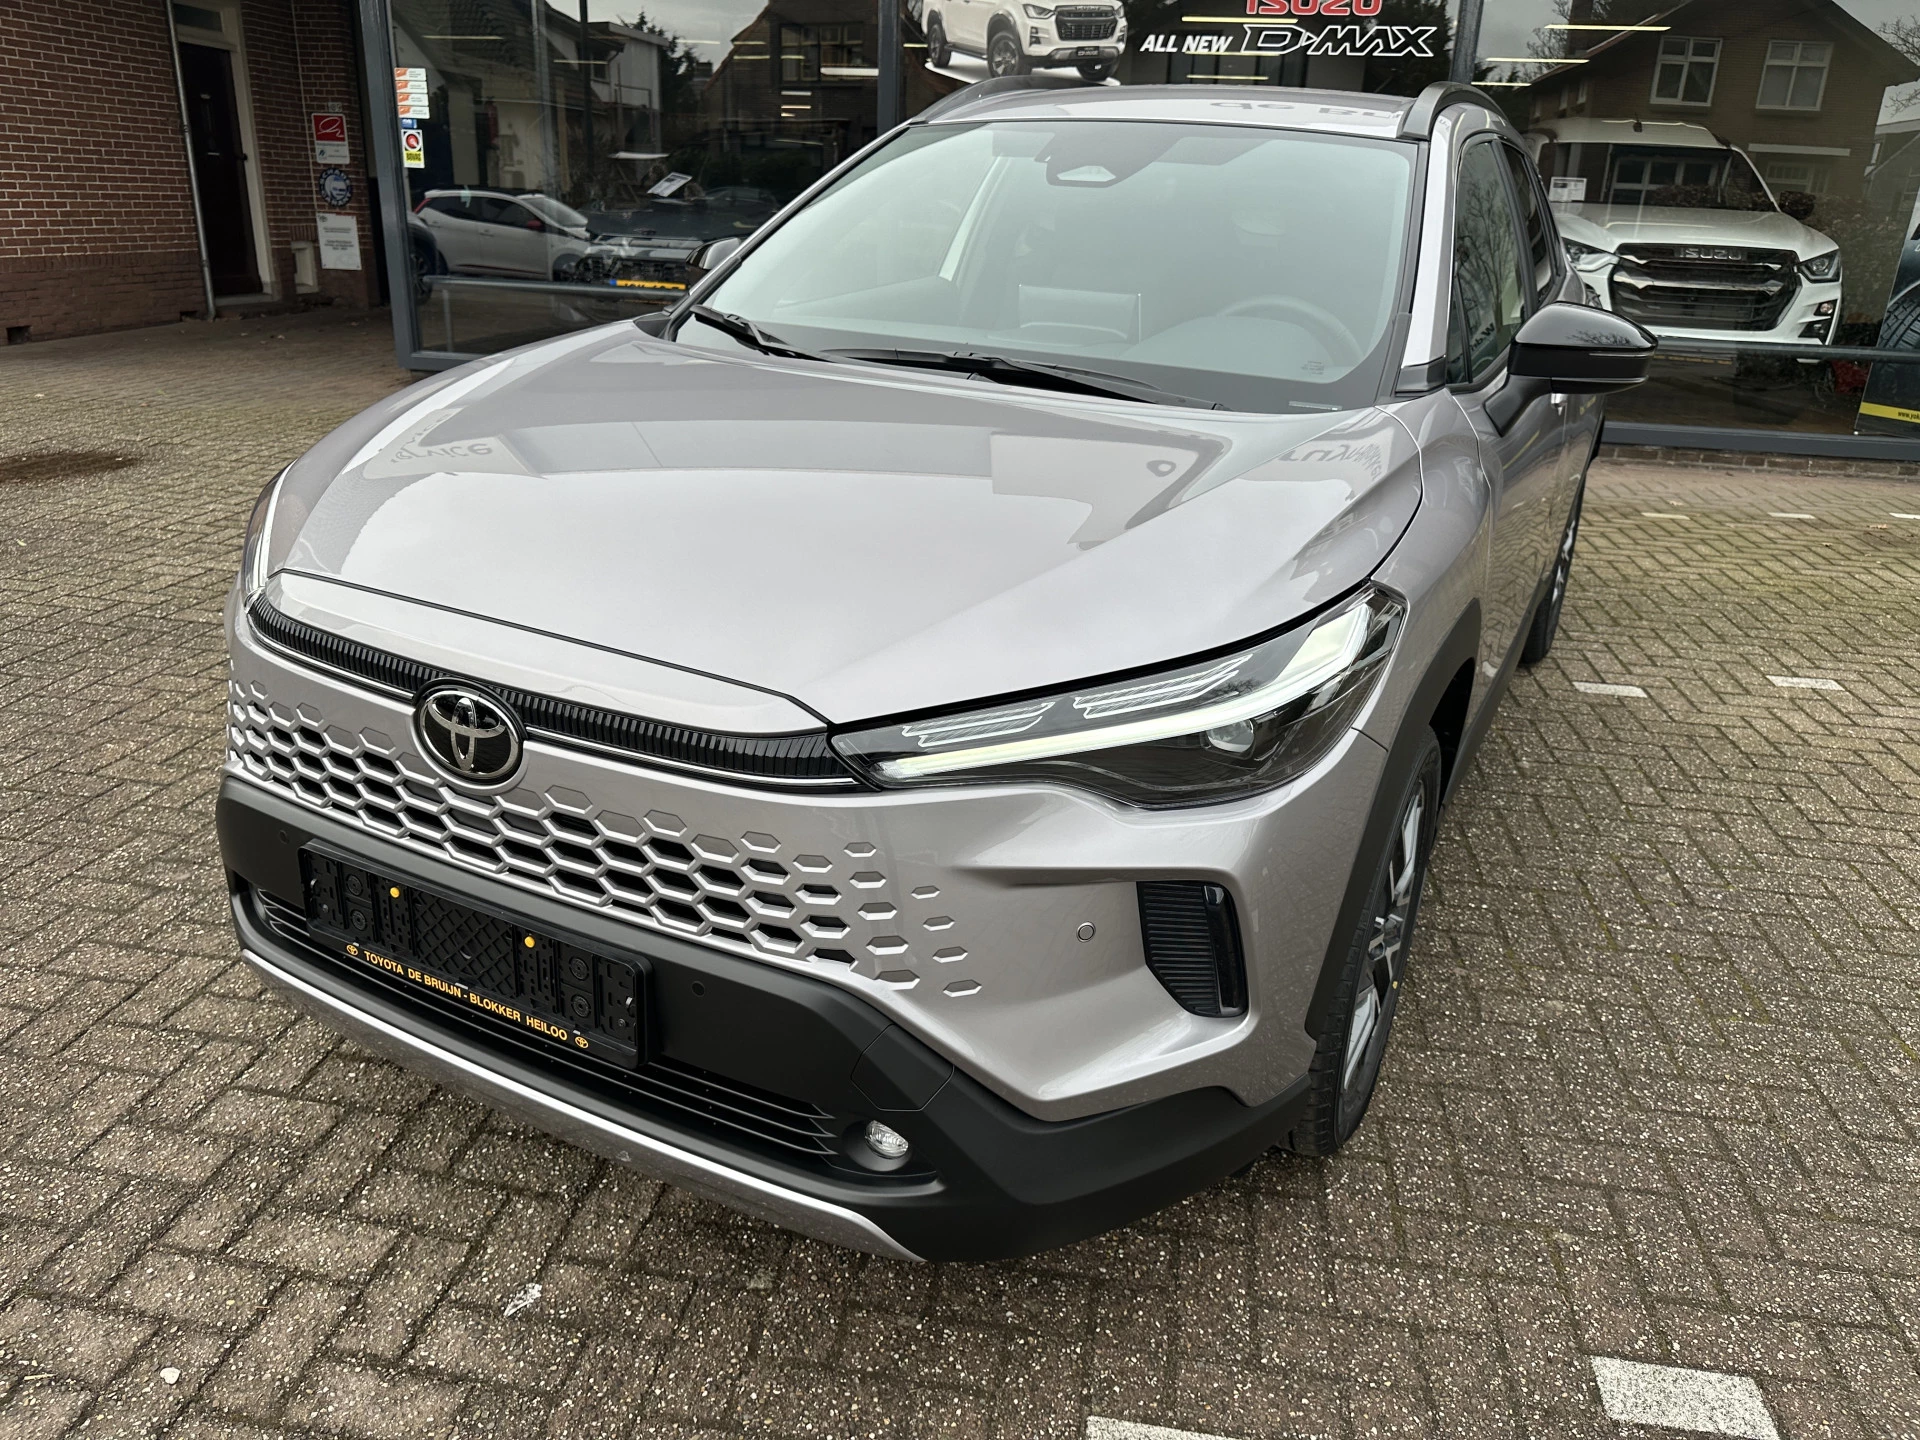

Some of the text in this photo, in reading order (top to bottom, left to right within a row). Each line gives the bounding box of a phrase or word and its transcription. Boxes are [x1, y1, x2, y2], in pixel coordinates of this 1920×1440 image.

[1246, 0, 1382, 16] ISUZU
[1140, 24, 1437, 57] ALL NEW D-MAX
[1680, 247, 1742, 261] ISUZU
[364, 950, 404, 975] TOYOTA
[407, 968, 422, 983] DE
[423, 974, 462, 998] BRUIJN
[469, 992, 521, 1023] BLOKKER
[526, 1015, 568, 1041] HEILOO
